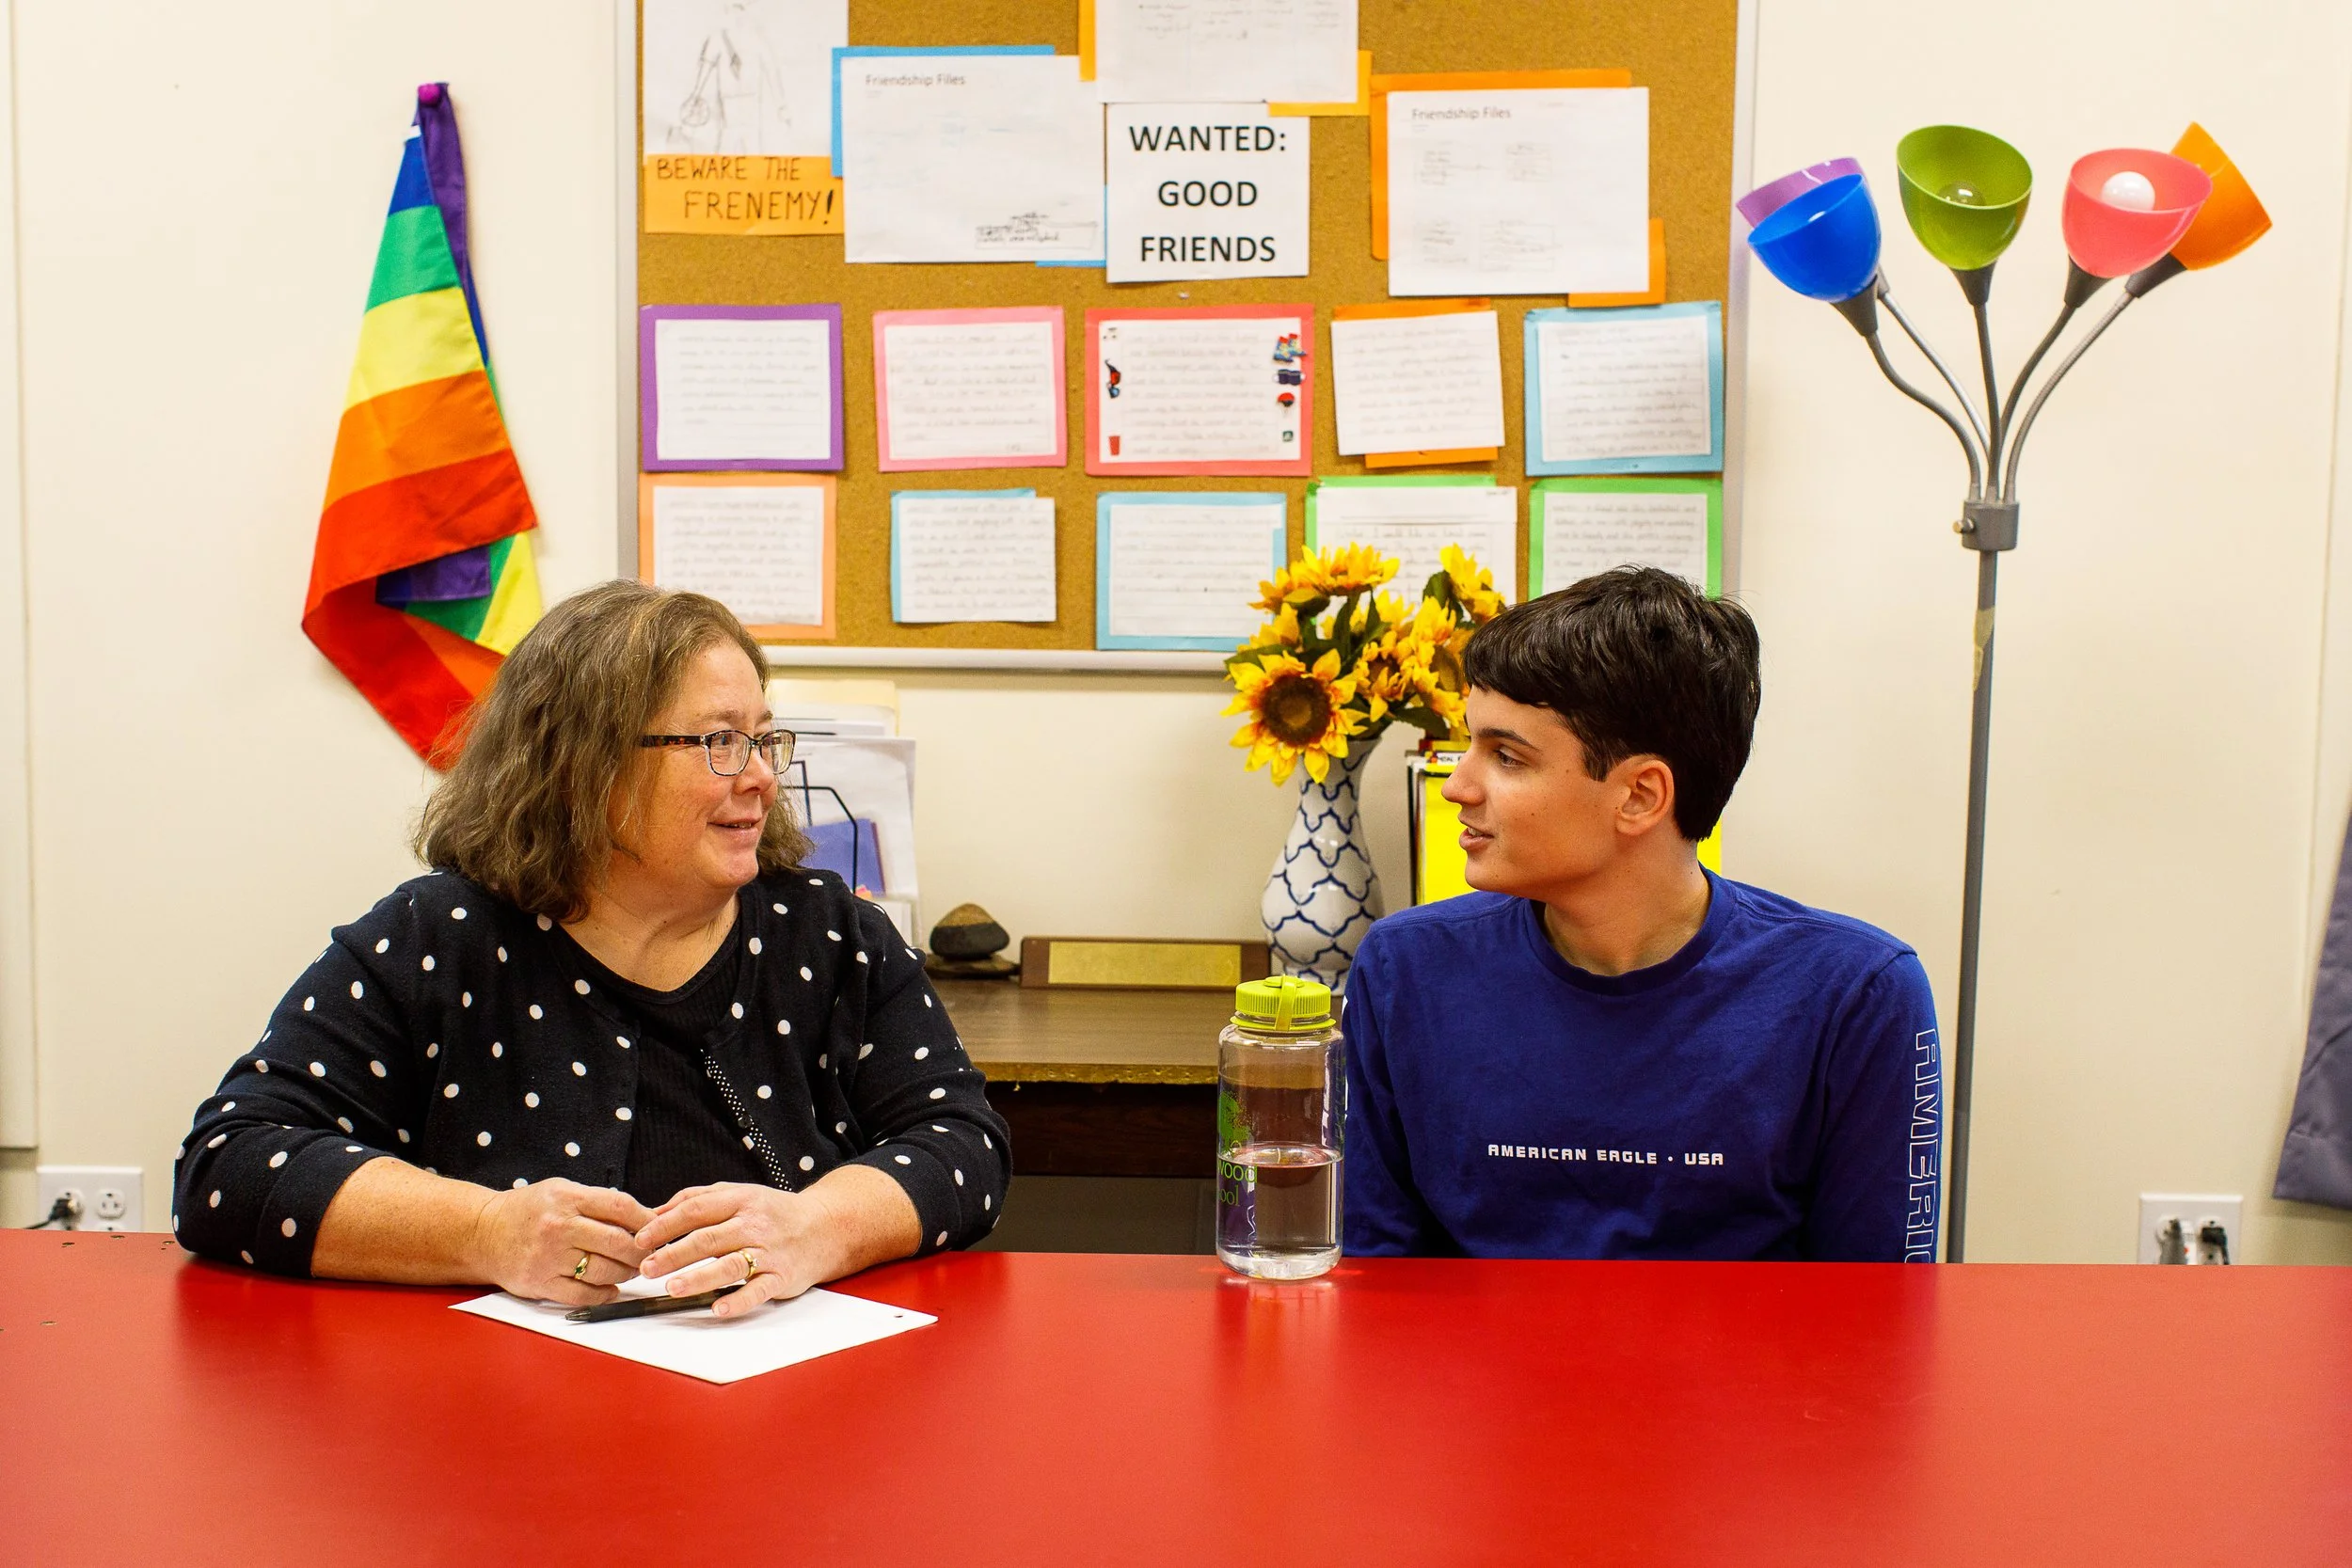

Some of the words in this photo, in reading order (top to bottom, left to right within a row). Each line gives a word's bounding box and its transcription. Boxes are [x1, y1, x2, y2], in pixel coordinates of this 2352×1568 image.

[865, 73, 933, 88] Friendship
[936, 72, 966, 86] Files
[1411, 107, 1481, 121] Friendship
[1483, 105, 1512, 119] Files
[1128, 125, 1286, 151] WANTED:
[657, 156, 749, 181] BEWARE
[764, 156, 802, 181] THE
[1157, 180, 1258, 207] GOOD
[684, 189, 834, 225] FRENEMY!
[1140, 236, 1277, 261] FRIENDS
[1487, 1144, 1587, 1161] AMERICAN
[1597, 1149, 1658, 1164] EAGLE
[1684, 1152, 1724, 1165] USA
[1904, 1028, 1940, 1263] AMERI
